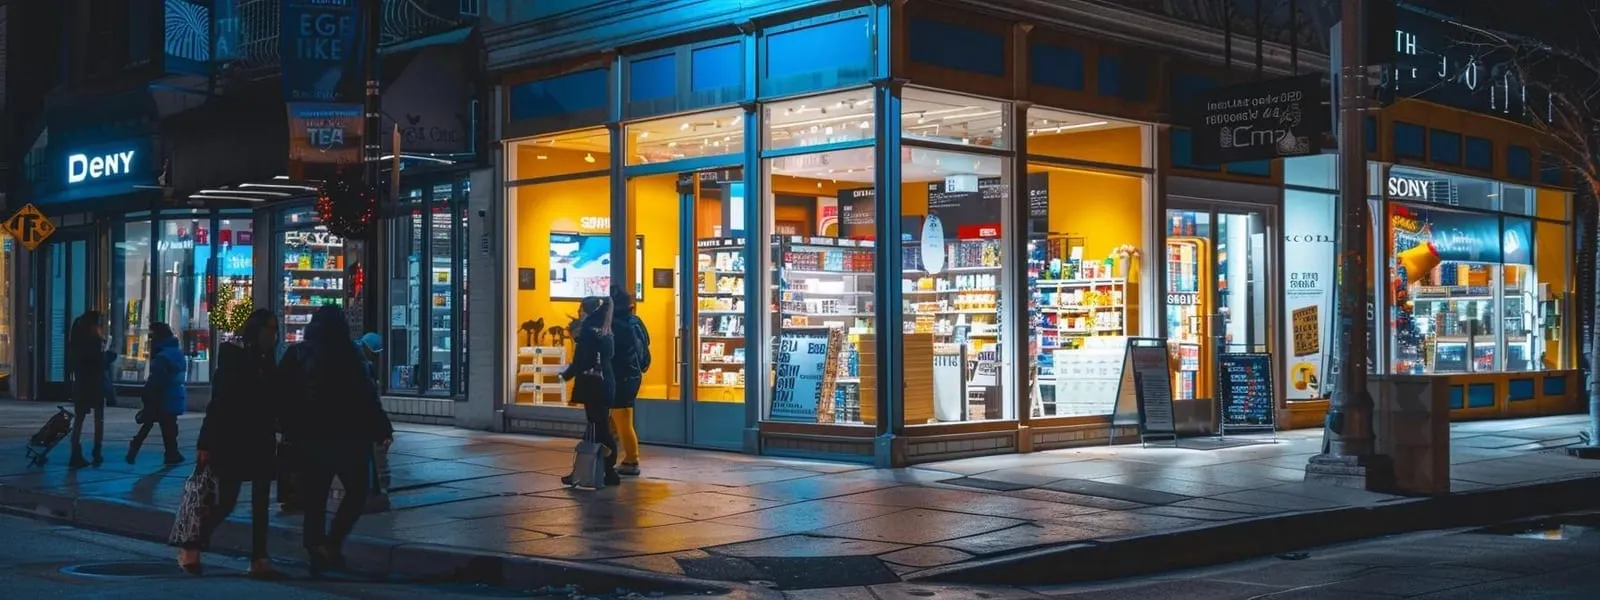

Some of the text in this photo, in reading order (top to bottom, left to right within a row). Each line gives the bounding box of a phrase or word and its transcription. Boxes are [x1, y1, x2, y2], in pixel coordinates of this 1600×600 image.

[1395, 29, 1417, 56] TH
[306, 128, 343, 147] TEA
[1389, 176, 1430, 201] SONY
